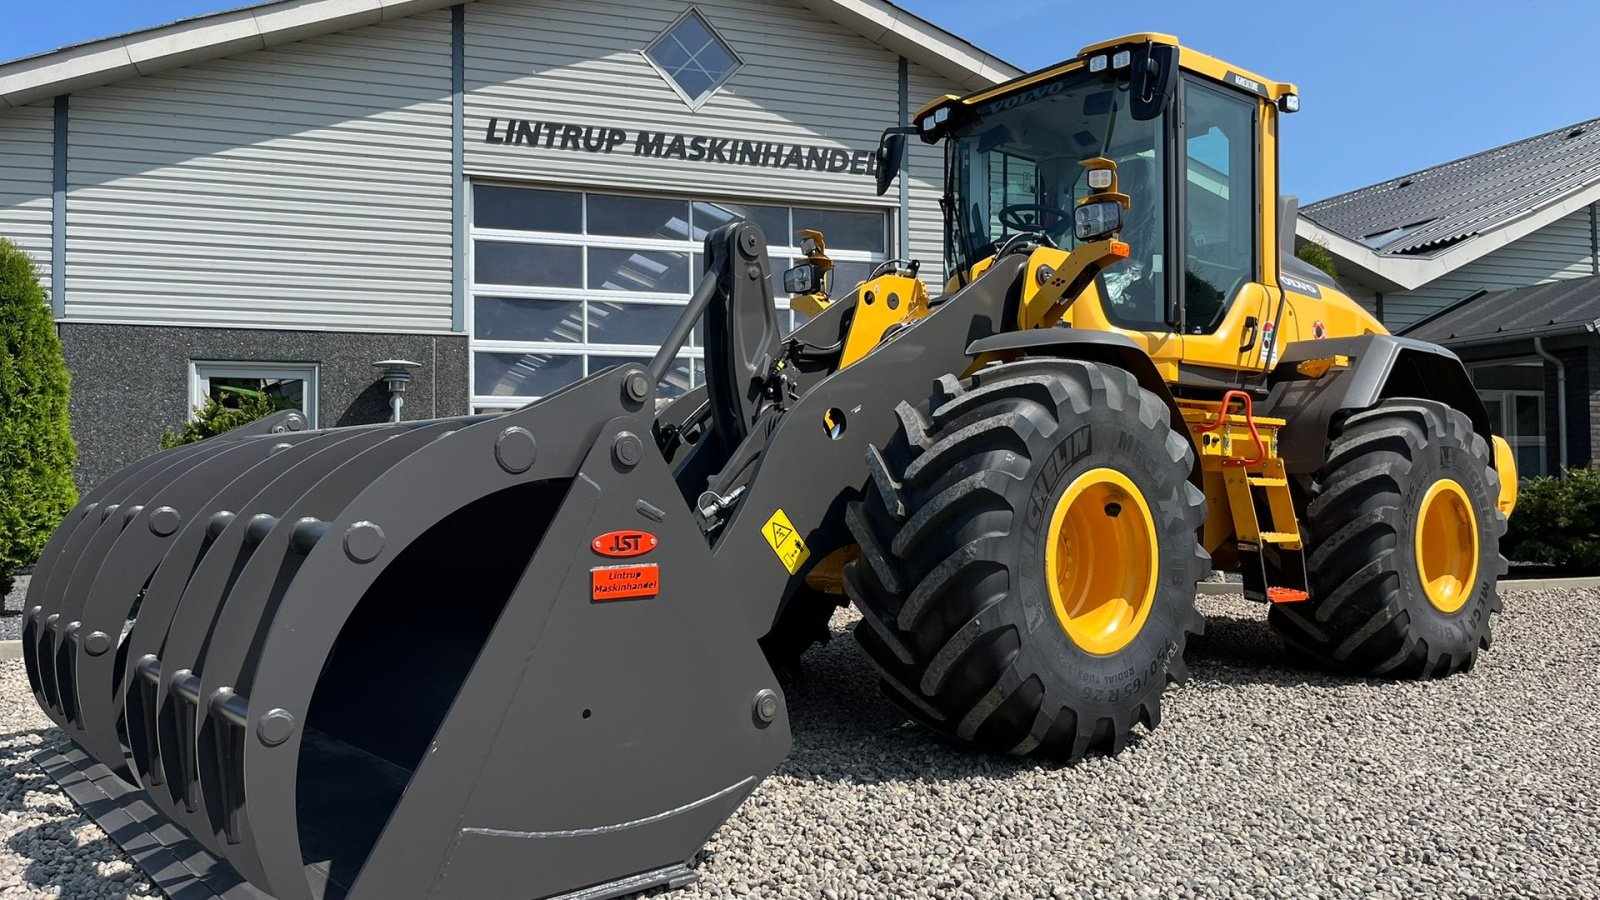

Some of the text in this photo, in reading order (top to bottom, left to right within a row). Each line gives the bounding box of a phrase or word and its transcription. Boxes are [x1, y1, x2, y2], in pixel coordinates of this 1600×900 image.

[989, 82, 1064, 113] VOLVO
[485, 117, 878, 177] LINTRUP MASKINHANDEL
[1281, 276, 1317, 293] OLVO
[608, 571, 642, 581] Lintrup
[594, 581, 657, 593] Maskinhandel
[1468, 582, 1490, 630] MEGA
[1103, 665, 1136, 685] RADIAL
[1108, 688, 1120, 703] R
